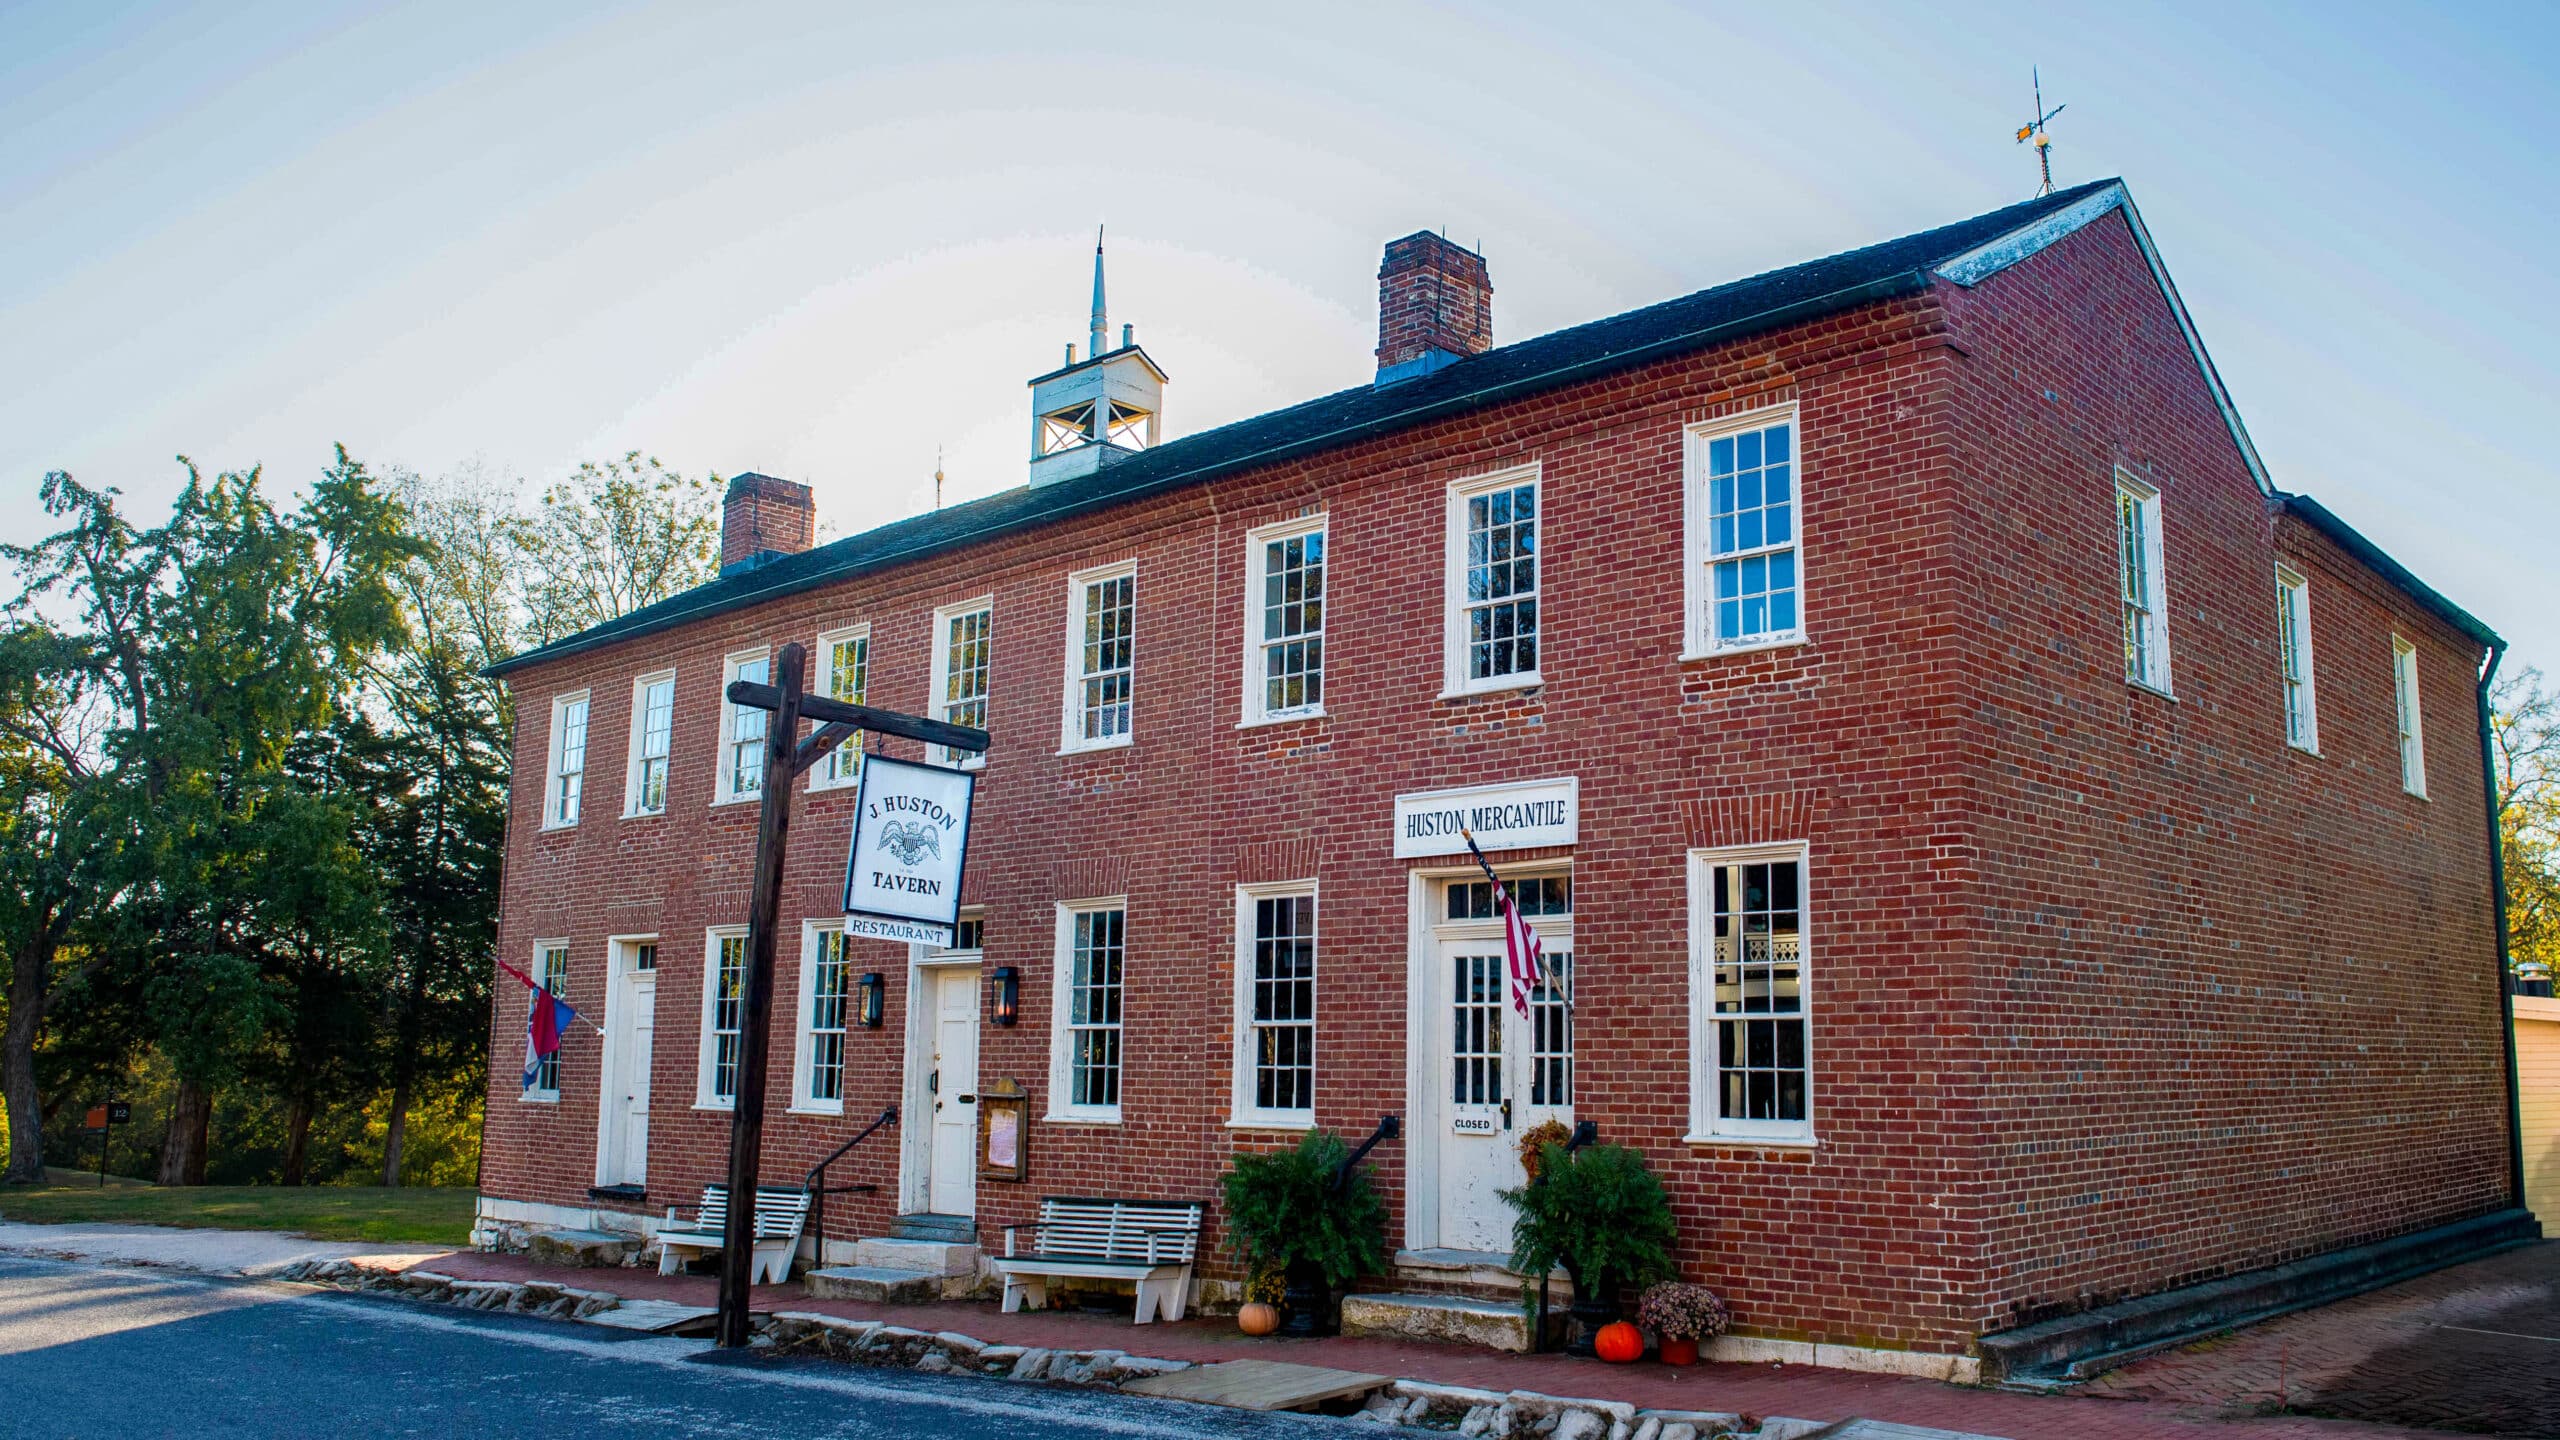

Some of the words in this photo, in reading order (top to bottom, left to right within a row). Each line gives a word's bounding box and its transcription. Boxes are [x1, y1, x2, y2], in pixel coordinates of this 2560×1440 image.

[869, 803, 882, 819] J.
[883, 796, 958, 831] HUSTON
[1406, 809, 1466, 838] HUSTON
[1471, 800, 1566, 833] MERCANTILE
[872, 872, 941, 896] TAVERN
[852, 919, 944, 943] RESTAURANT
[1455, 1119, 1490, 1129] CLOSED
